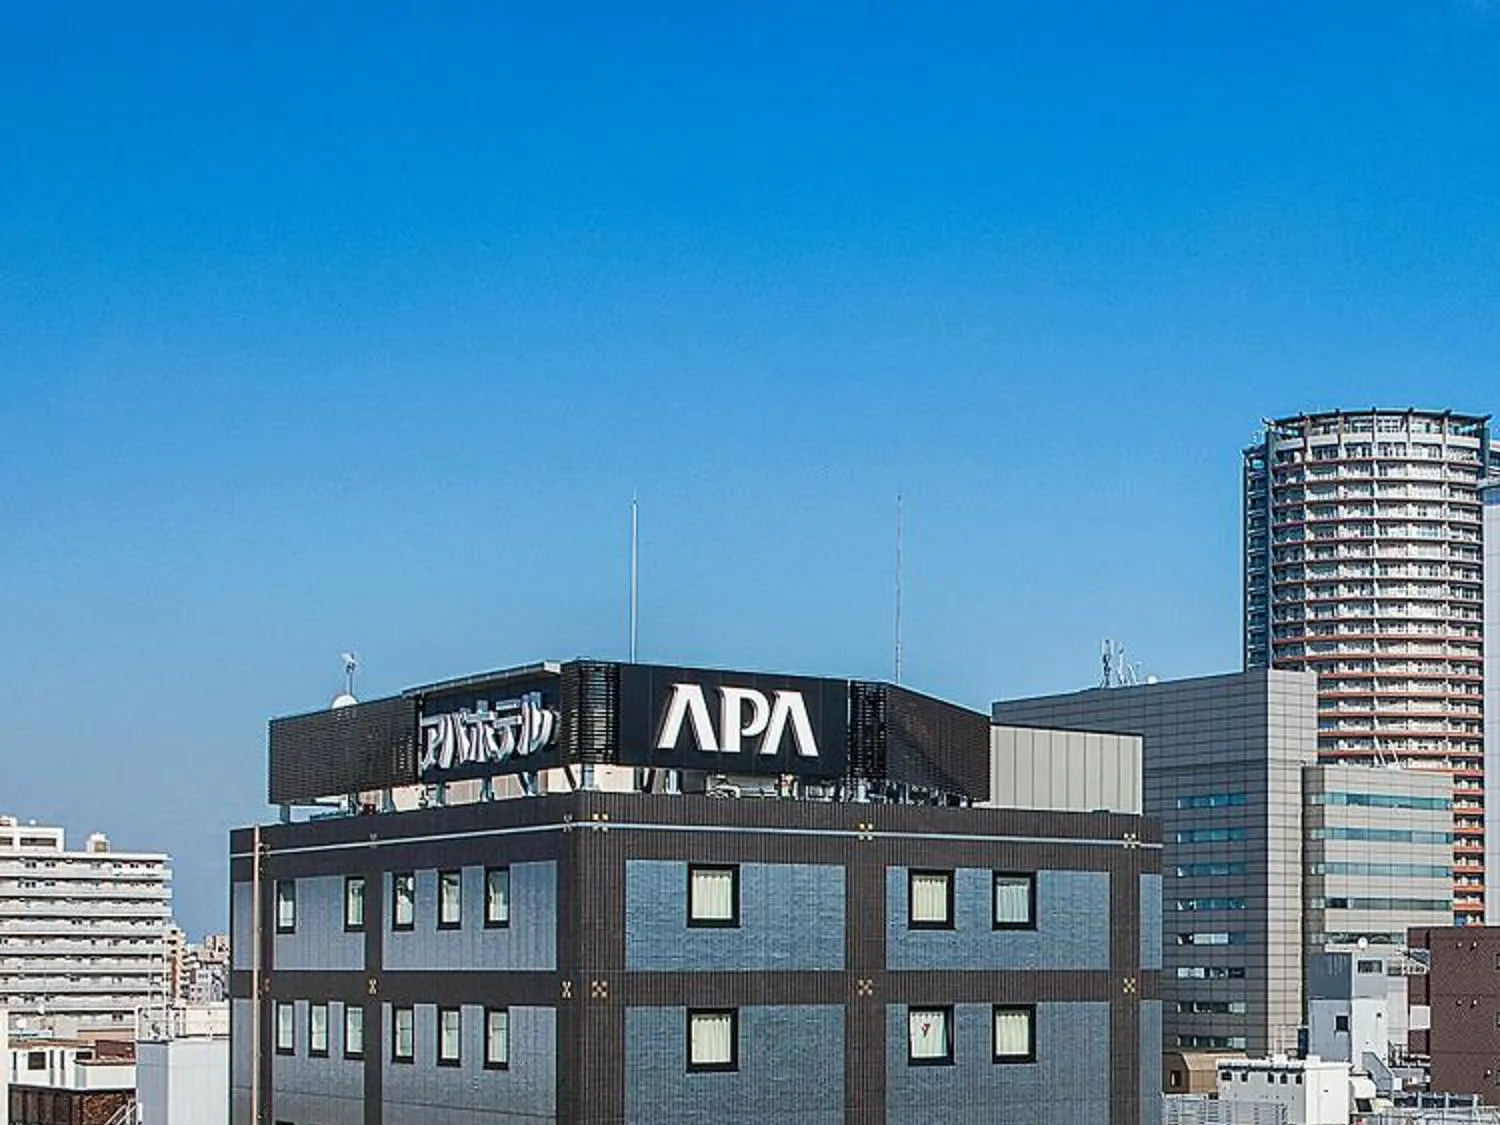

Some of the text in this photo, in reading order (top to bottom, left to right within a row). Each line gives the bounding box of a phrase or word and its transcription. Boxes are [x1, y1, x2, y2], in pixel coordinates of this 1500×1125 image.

[421, 692, 558, 770] アパホテル
[656, 683, 819, 757] APA
